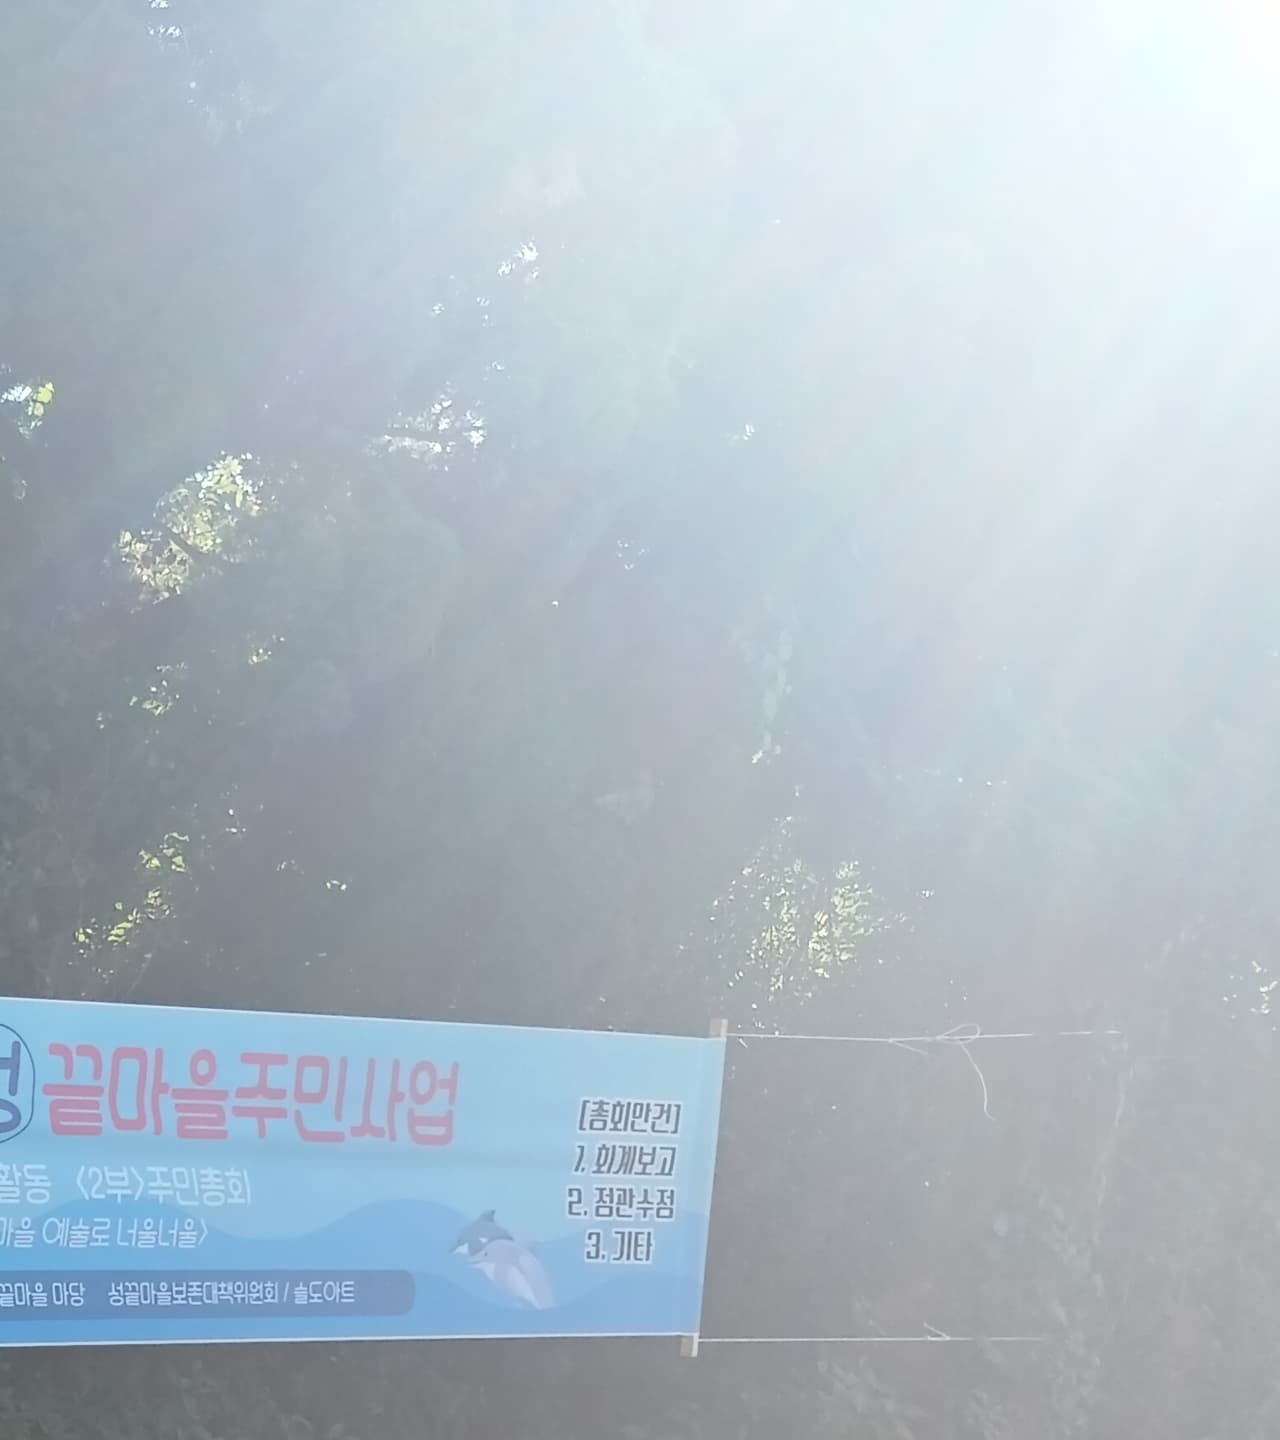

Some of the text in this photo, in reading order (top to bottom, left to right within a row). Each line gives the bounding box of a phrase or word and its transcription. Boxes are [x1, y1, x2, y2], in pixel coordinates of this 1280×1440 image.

[567, 1187, 588, 1217] 2.
[586, 1231, 653, 1262] 3. 기타
[52, 1282, 86, 1307] 마당
